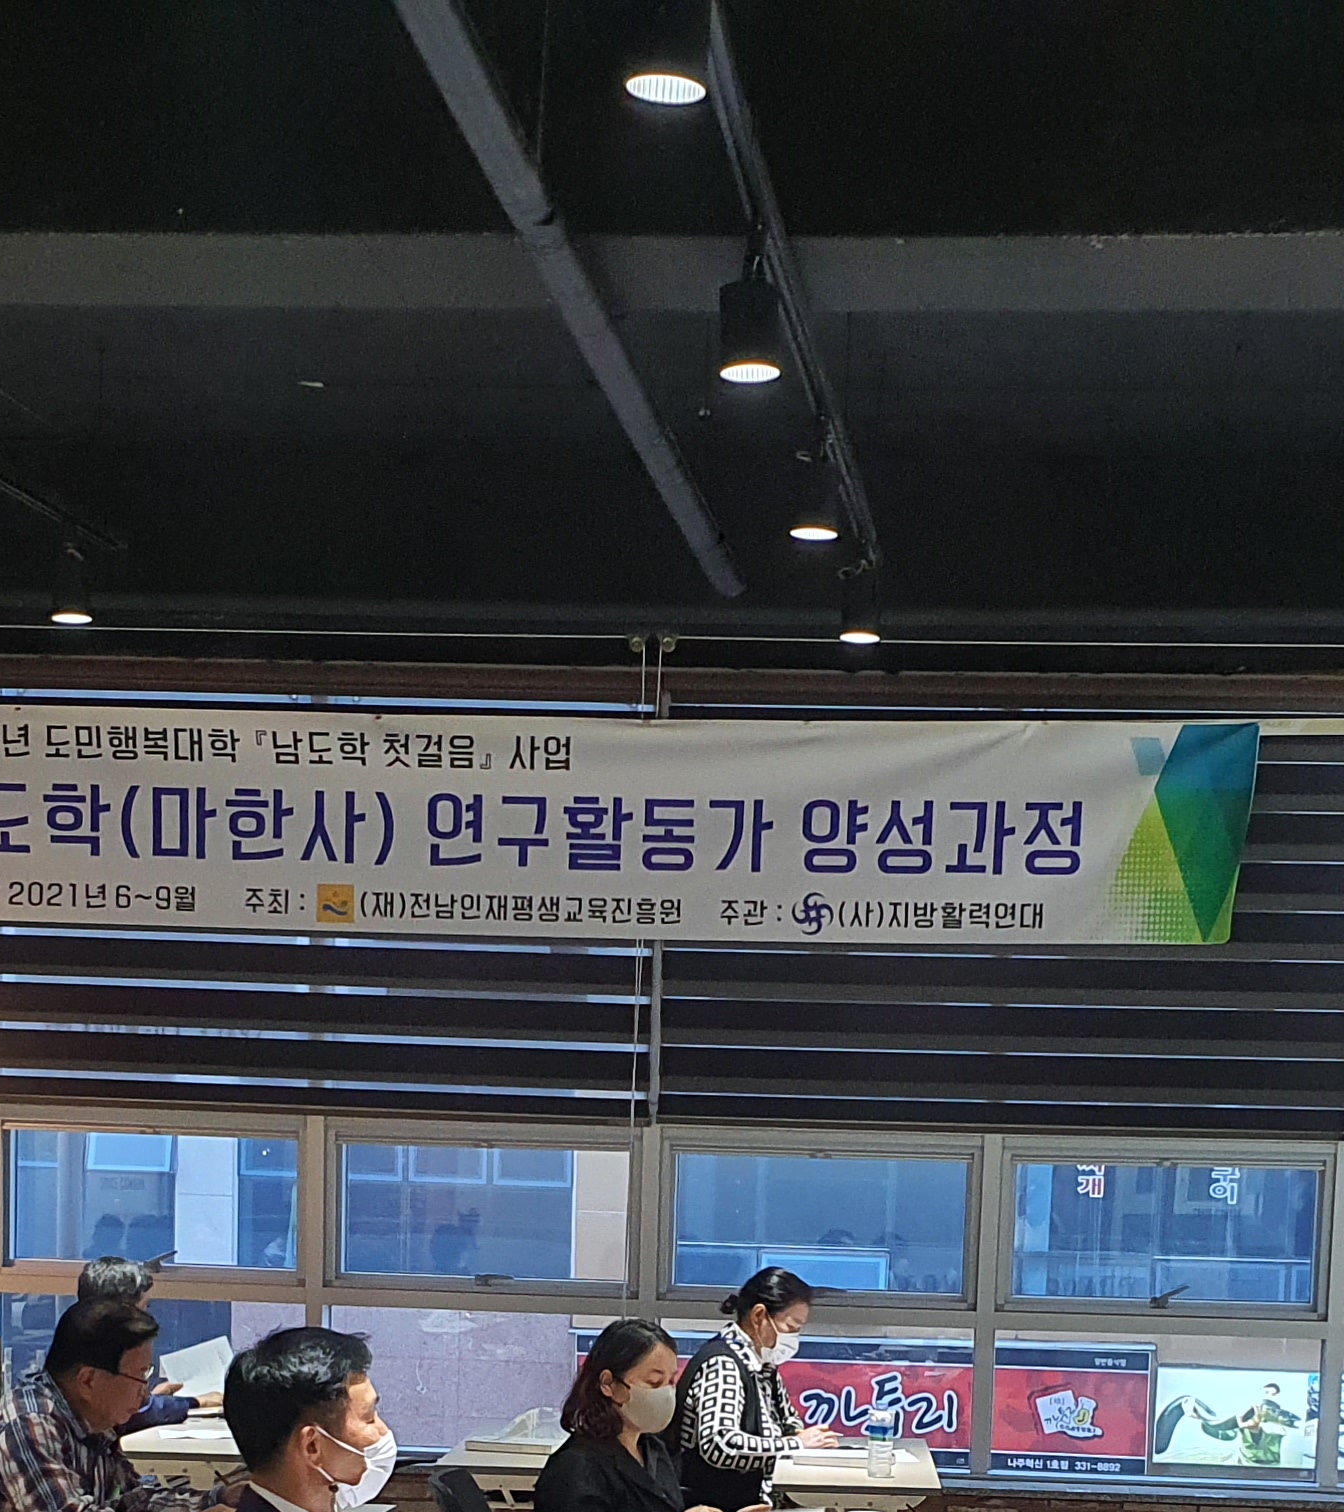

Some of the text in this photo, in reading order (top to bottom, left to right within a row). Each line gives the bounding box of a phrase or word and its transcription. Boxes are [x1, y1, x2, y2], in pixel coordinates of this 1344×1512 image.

[44, 724, 241, 764] 도민행복대학
[508, 734, 572, 772] 사업
[427, 792, 774, 874] 연구활동가
[801, 798, 1083, 876] 양성과정
[7, 880, 107, 910] 2021년
[115, 884, 196, 913] 6~9월
[360, 890, 682, 925] (재)전남인재평생교육진흥원
[838, 900, 1044, 930] (사)지방활력연대
